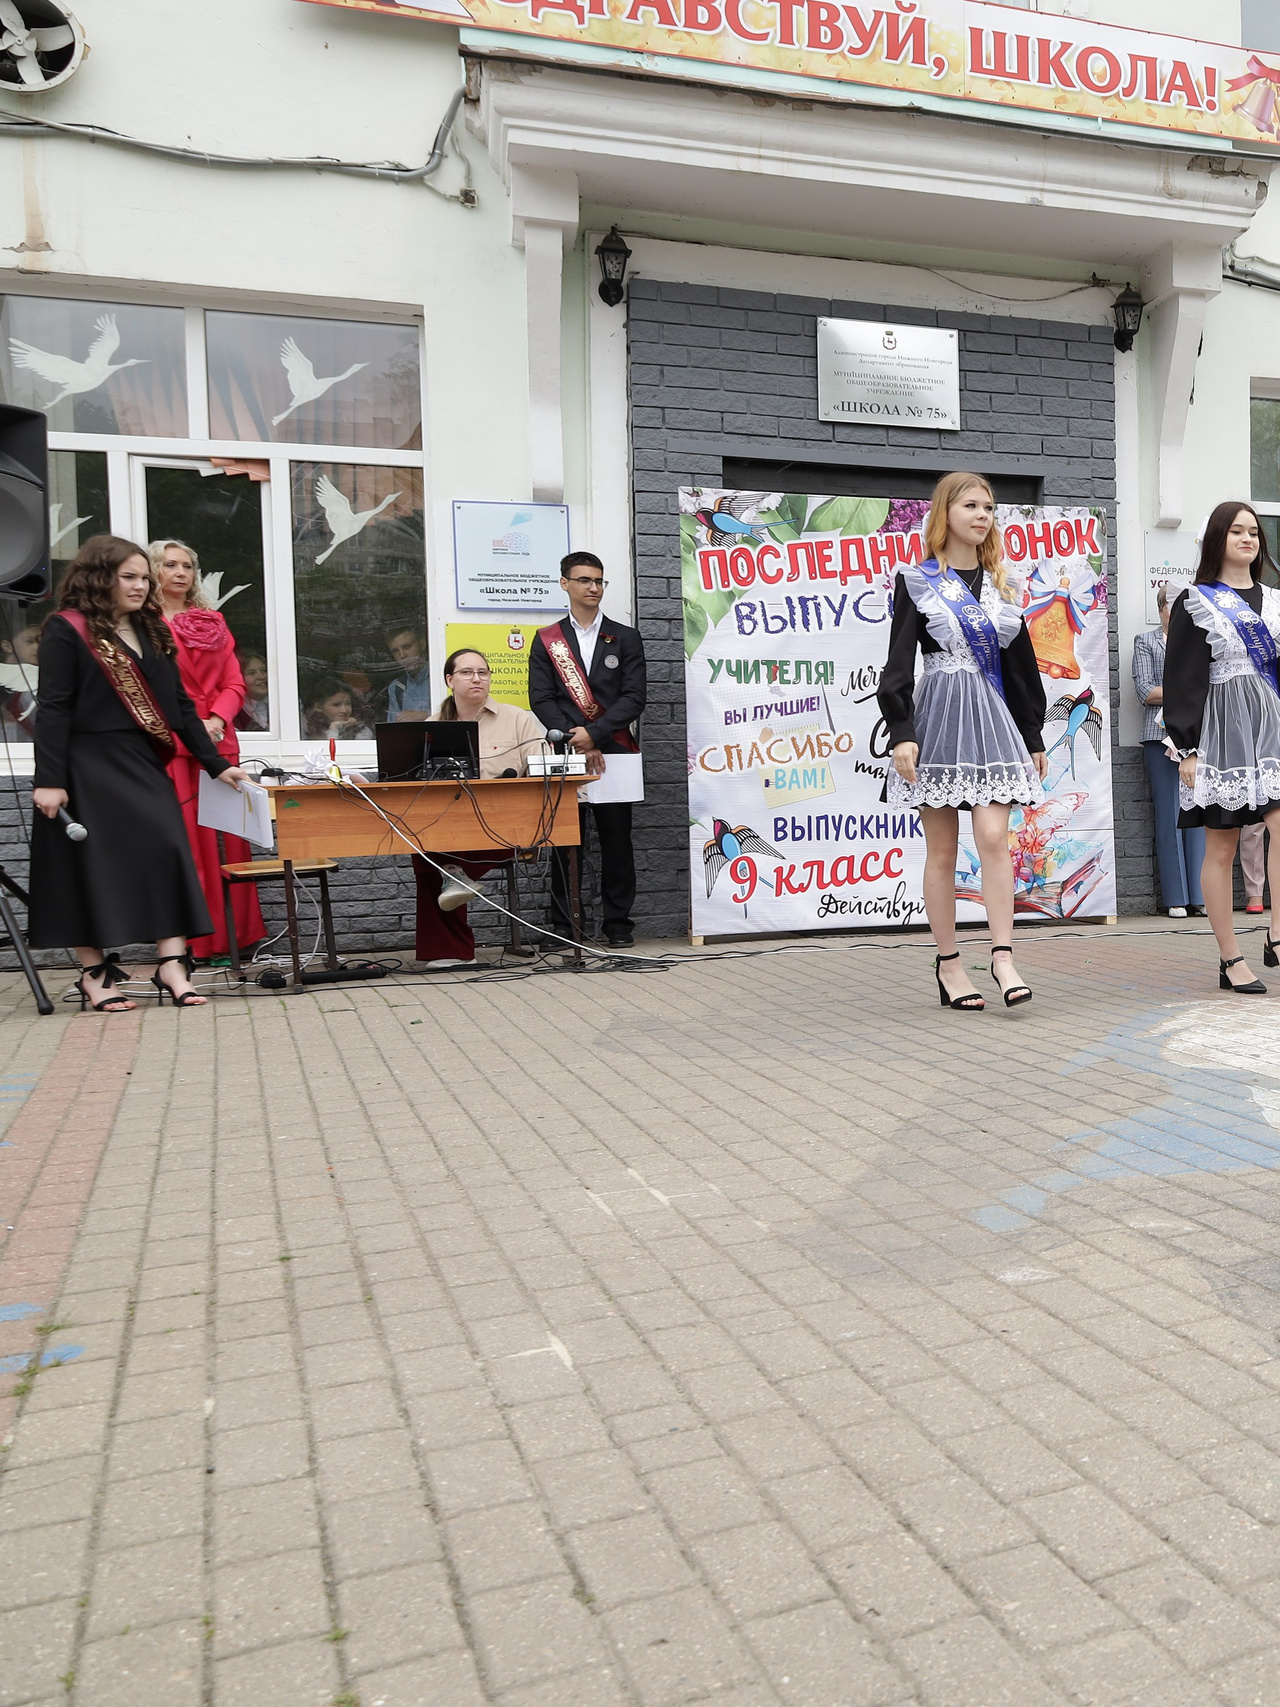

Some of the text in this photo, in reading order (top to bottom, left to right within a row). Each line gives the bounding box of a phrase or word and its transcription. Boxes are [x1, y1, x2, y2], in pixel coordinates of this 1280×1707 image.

[969, 26, 1218, 111] ШКОЛА!
[846, 379, 934, 391] ОБЩЕОБРАЗОВАТЕЛЬНОЕ
[900, 376, 946, 385] БЮДЖЕТНОЕ
[866, 387, 915, 397] УЧРЕЖДЕНИЕ
[833, 400, 947, 418] «ШКОЛА № 75»
[699, 532, 924, 590] ПОСЛЕДНИ
[1149, 566, 1198, 576] ФЕДЕРАЛЬН
[480, 586, 549, 595] «Школа № 75»
[707, 658, 834, 685] УЧИТЕЛЯ!
[724, 695, 820, 725] ВЫ ЛУЧШИЕ!
[699, 732, 854, 773] СПАСИБО
[774, 768, 826, 790] ВАМ!
[730, 847, 904, 904] 9 класс
